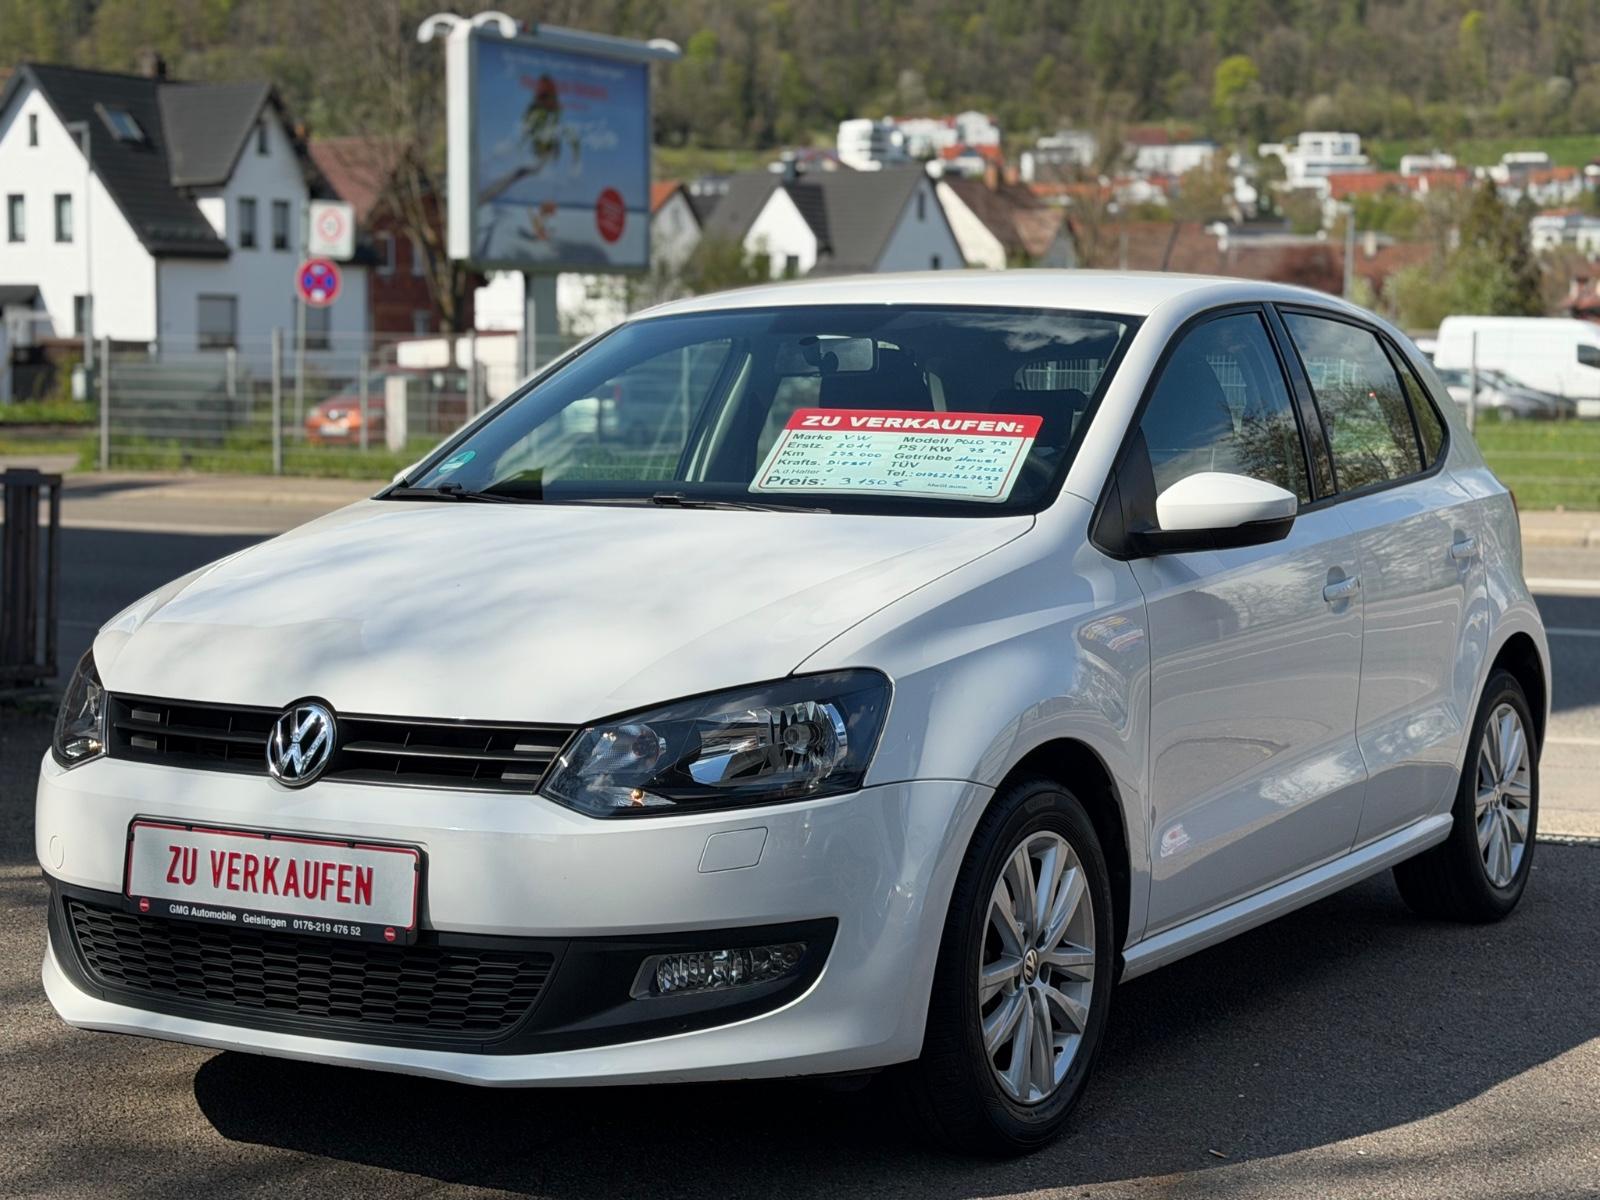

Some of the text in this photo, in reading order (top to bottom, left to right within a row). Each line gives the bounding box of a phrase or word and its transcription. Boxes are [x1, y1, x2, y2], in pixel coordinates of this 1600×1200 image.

[801, 415, 1025, 433] ZU VERKAUFEN:
[792, 433, 833, 442] Marke
[903, 436, 949, 445] Modell
[787, 441, 824, 449] Erstz.
[894, 451, 953, 463] Getriebe
[777, 458, 822, 467] Krafts.
[890, 460, 920, 469] TÜV
[765, 475, 827, 487] Preis:
[166, 845, 375, 907] ZU VERKAUFEN
[169, 904, 362, 937] GMG Automobile Geislingen 0176-219 476 52
